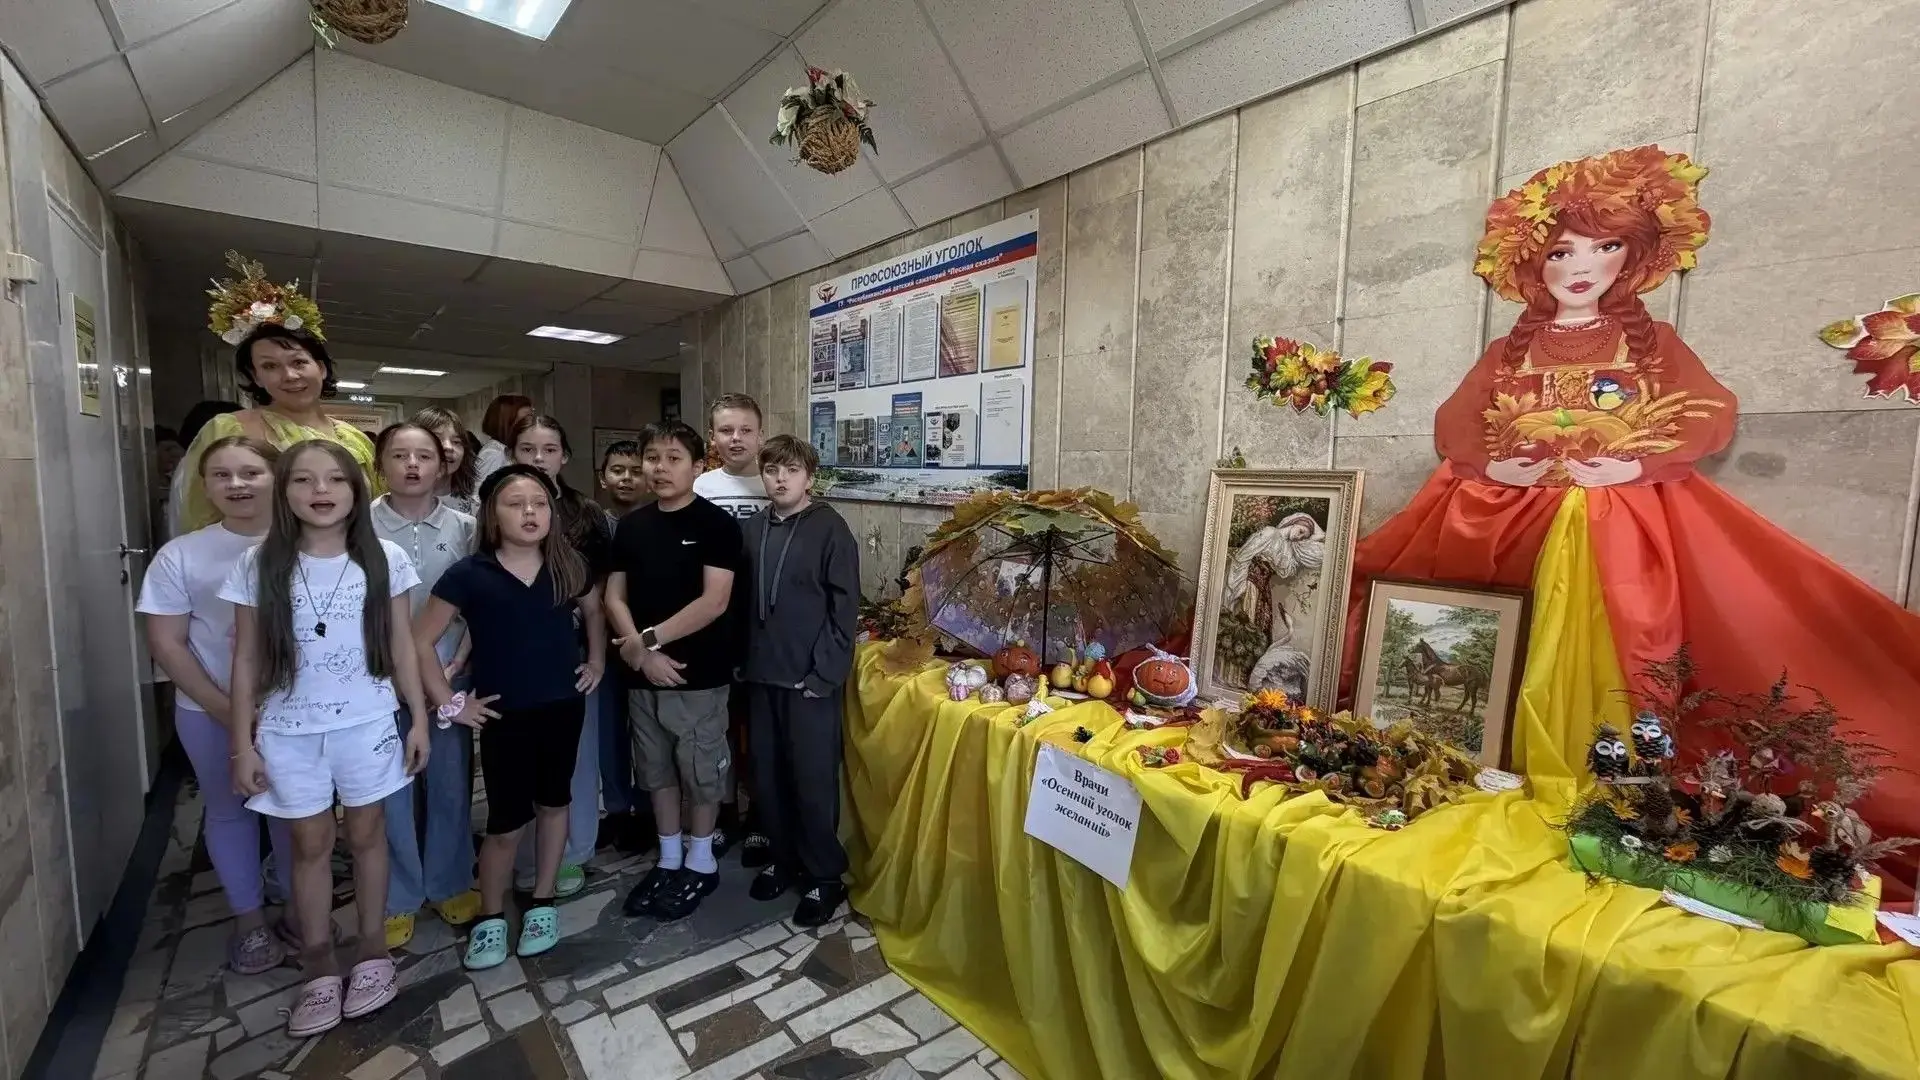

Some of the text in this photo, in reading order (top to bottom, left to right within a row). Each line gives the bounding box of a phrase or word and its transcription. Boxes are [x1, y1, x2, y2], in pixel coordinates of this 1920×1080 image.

[851, 236, 983, 291] ПРОФСОЮЗНЫЙ УГОЛОК
[1041, 777, 1133, 831] «Осенний уголок
[1073, 769, 1109, 797] Врачи
[1054, 803, 1111, 838] желаний»
